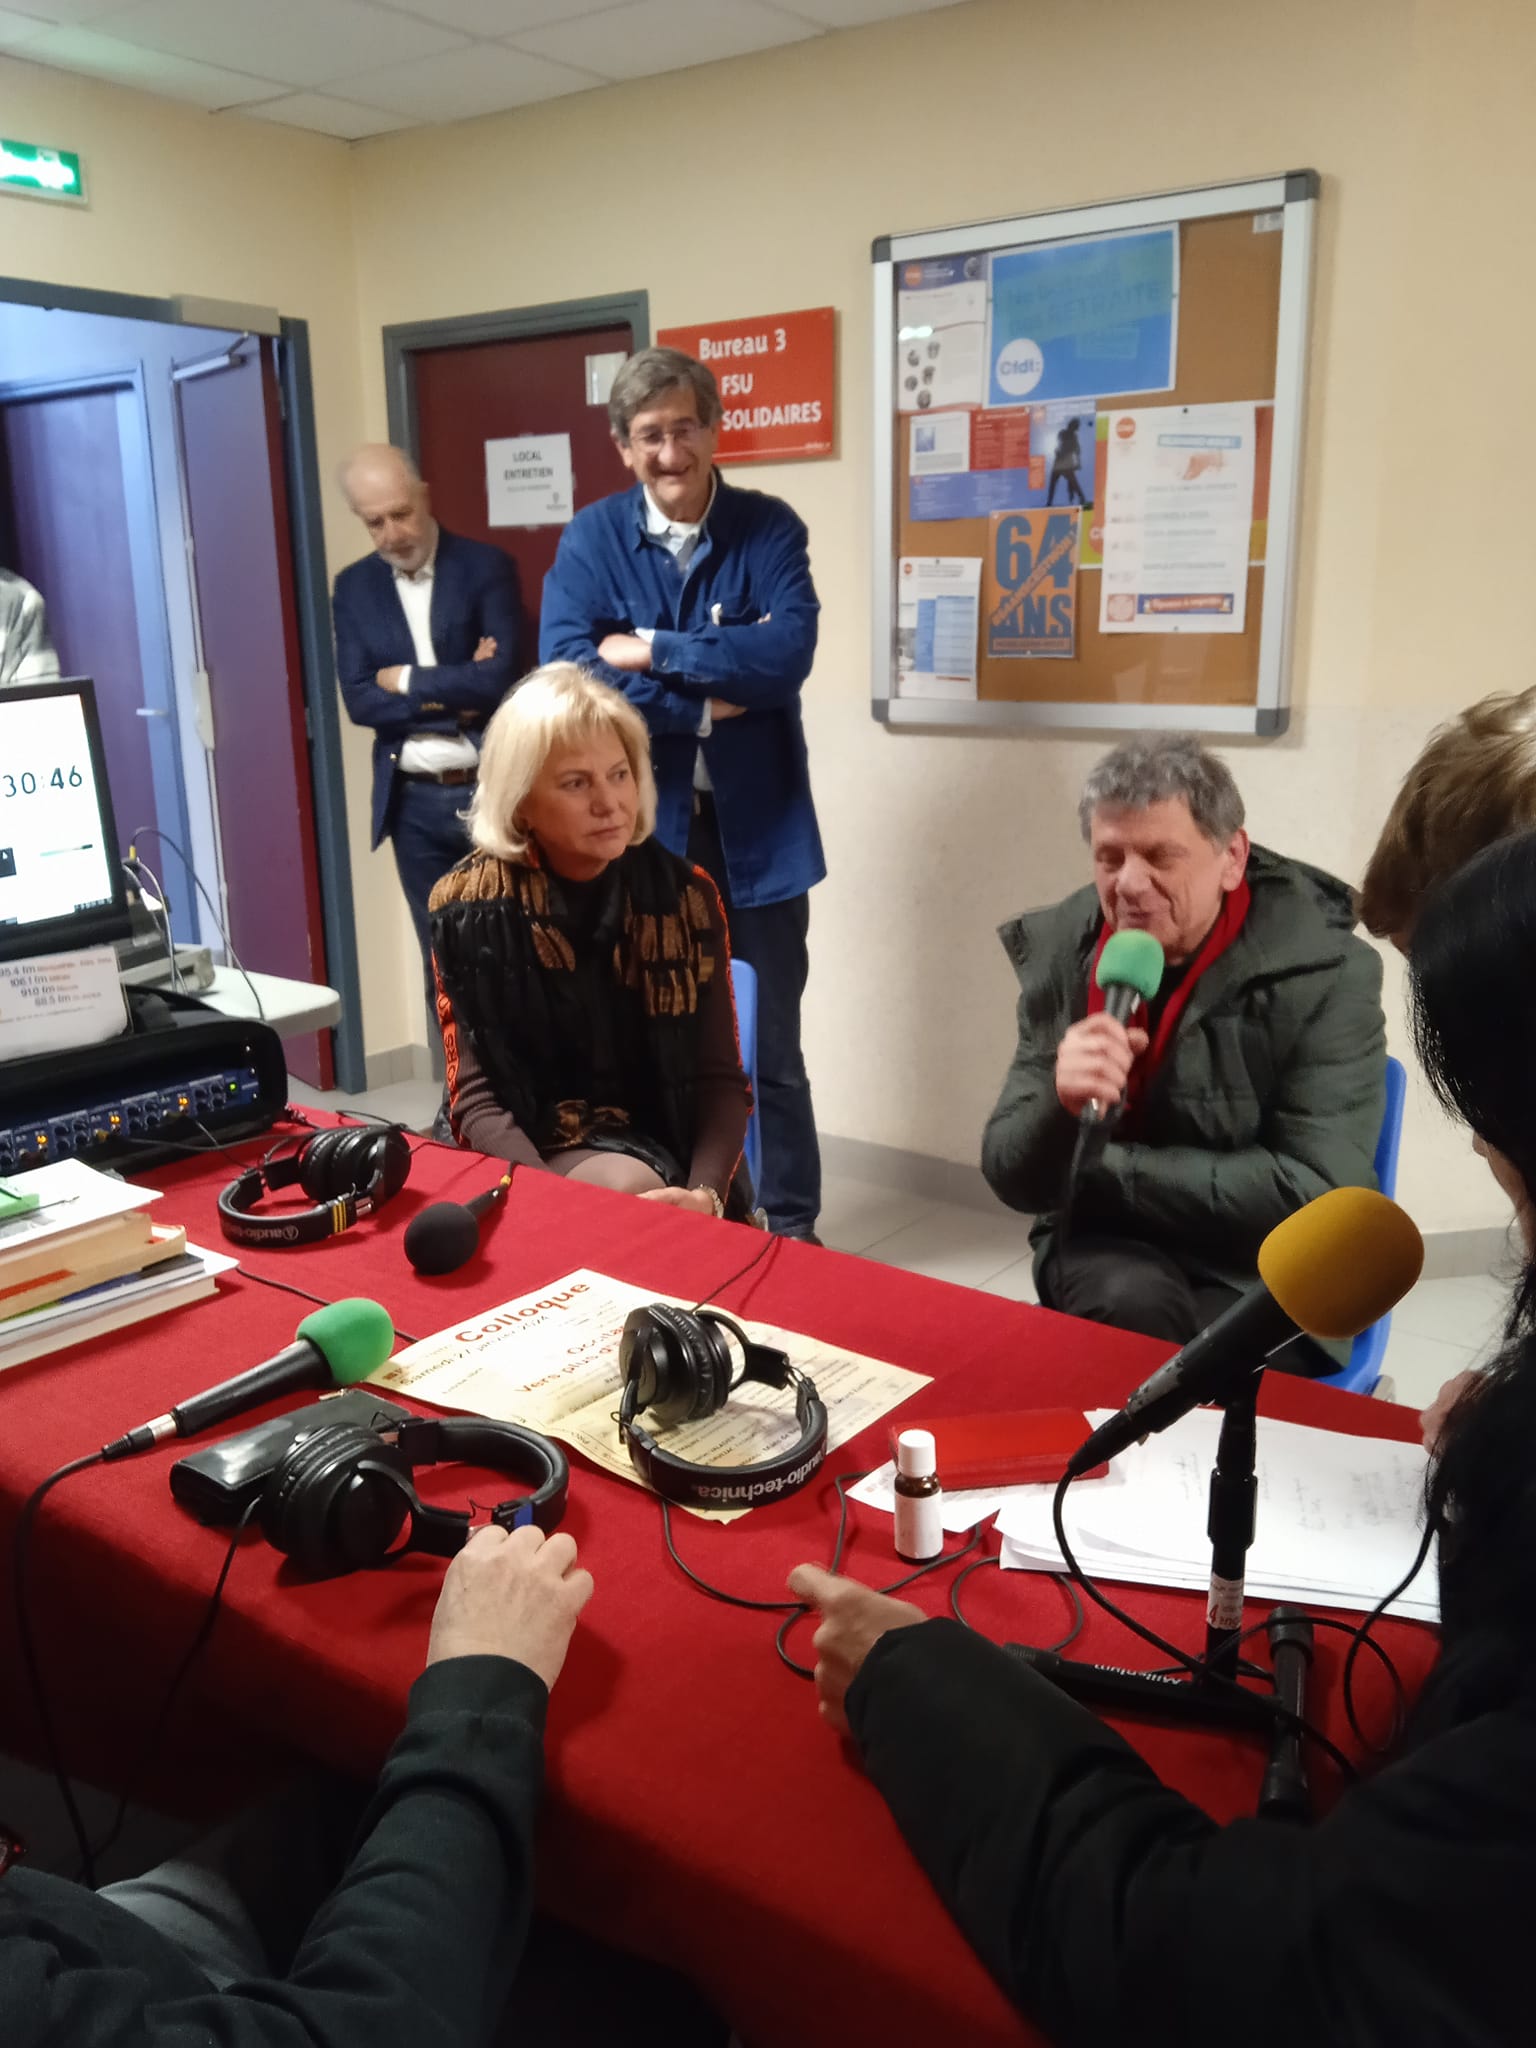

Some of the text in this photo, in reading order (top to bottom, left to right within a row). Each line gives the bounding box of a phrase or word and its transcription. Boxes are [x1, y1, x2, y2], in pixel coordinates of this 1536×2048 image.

[699, 328, 787, 360] Bureau 3
[721, 373, 753, 396] FSU
[722, 401, 821, 431] SOLIDAIRES
[512, 450, 543, 462] LOCAL
[504, 466, 553, 480] ENTRETIEN
[996, 514, 1074, 591] 64
[989, 594, 1073, 638] ANS
[455, 1283, 590, 1342] Colloque
[514, 1373, 560, 1393] Vers
[698, 1450, 824, 1502] audio-technica
